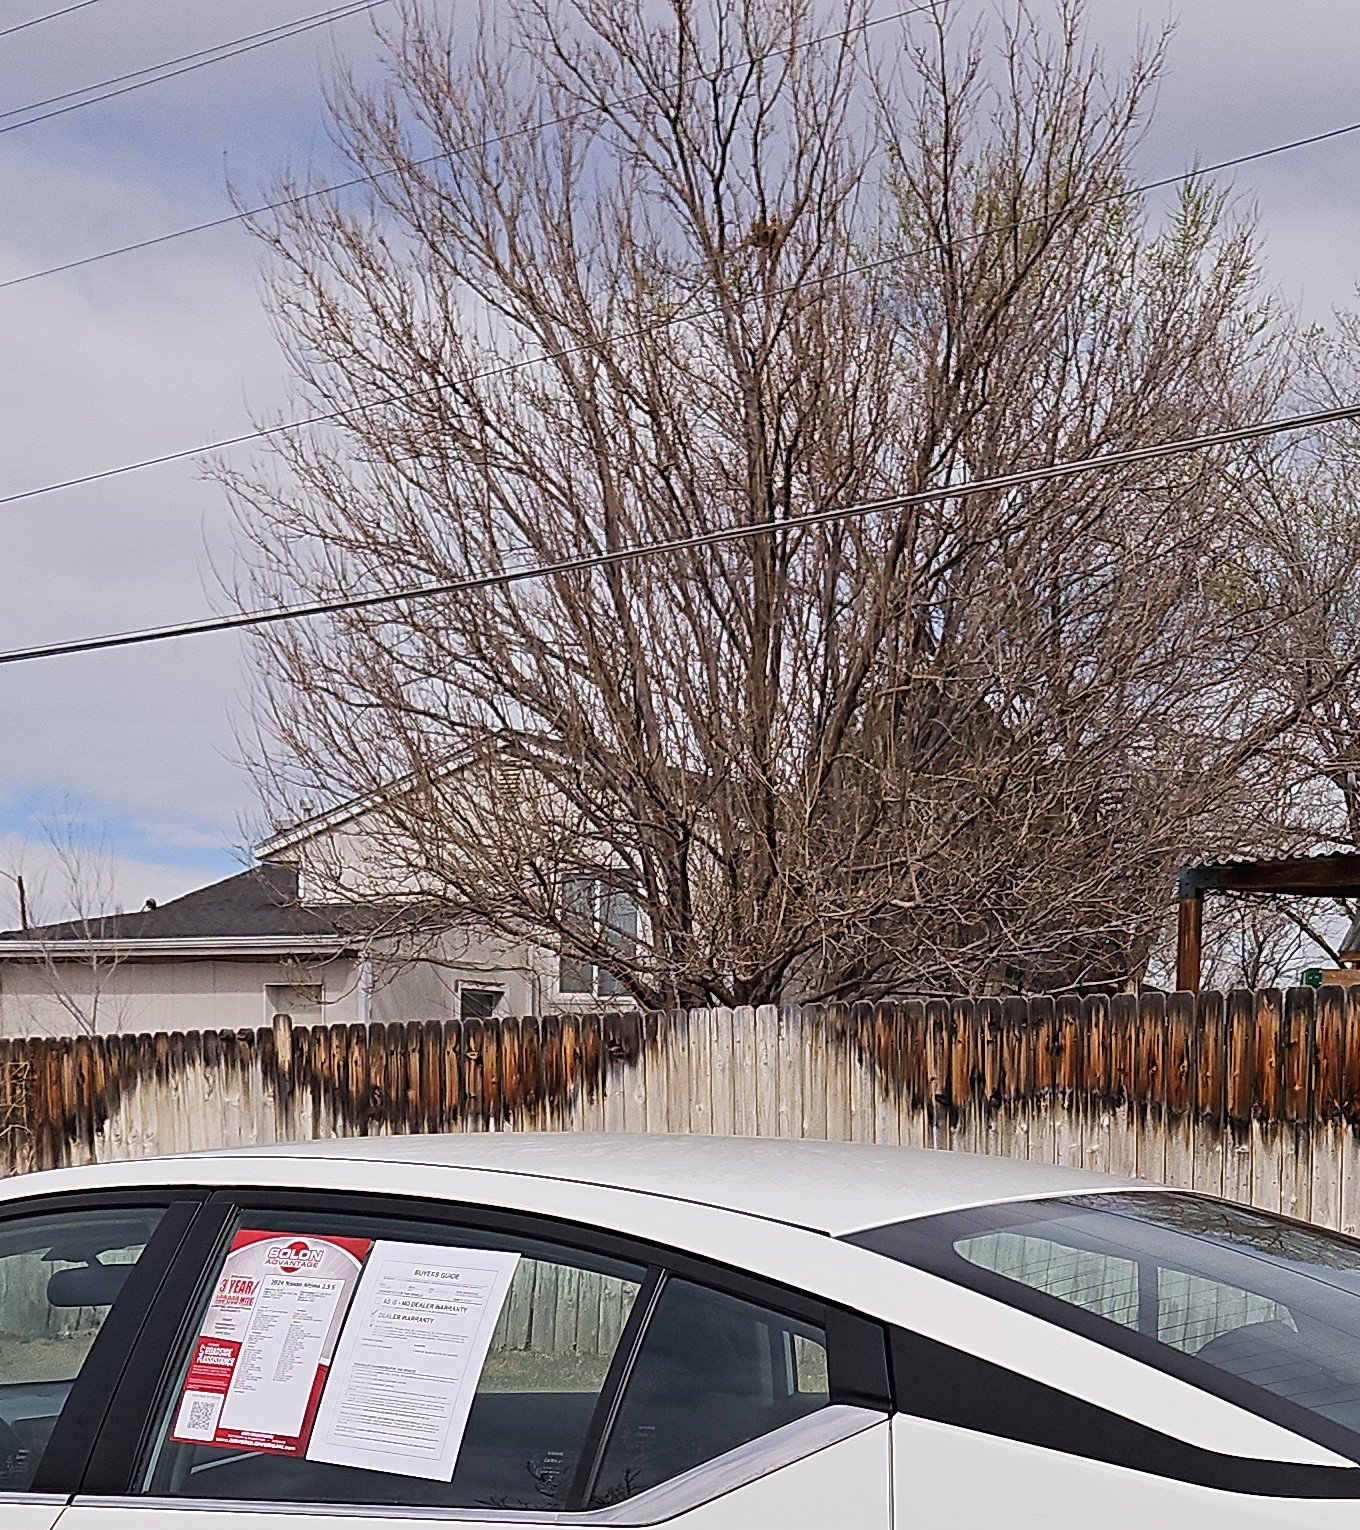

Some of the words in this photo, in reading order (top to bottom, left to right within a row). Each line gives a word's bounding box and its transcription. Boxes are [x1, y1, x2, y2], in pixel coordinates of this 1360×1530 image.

[268, 1247, 324, 1262] SOLON
[265, 1259, 319, 1269] ADVANTAGE
[414, 1269, 440, 1278] BUYERS
[440, 1272, 460, 1280] GUIDE
[219, 1279, 228, 1293] 3
[410, 1301, 435, 1310] DEALER
[435, 1304, 468, 1313] WARRANTY
[378, 1312, 401, 1320] DEALER
[401, 1315, 435, 1324] WARRANTY
